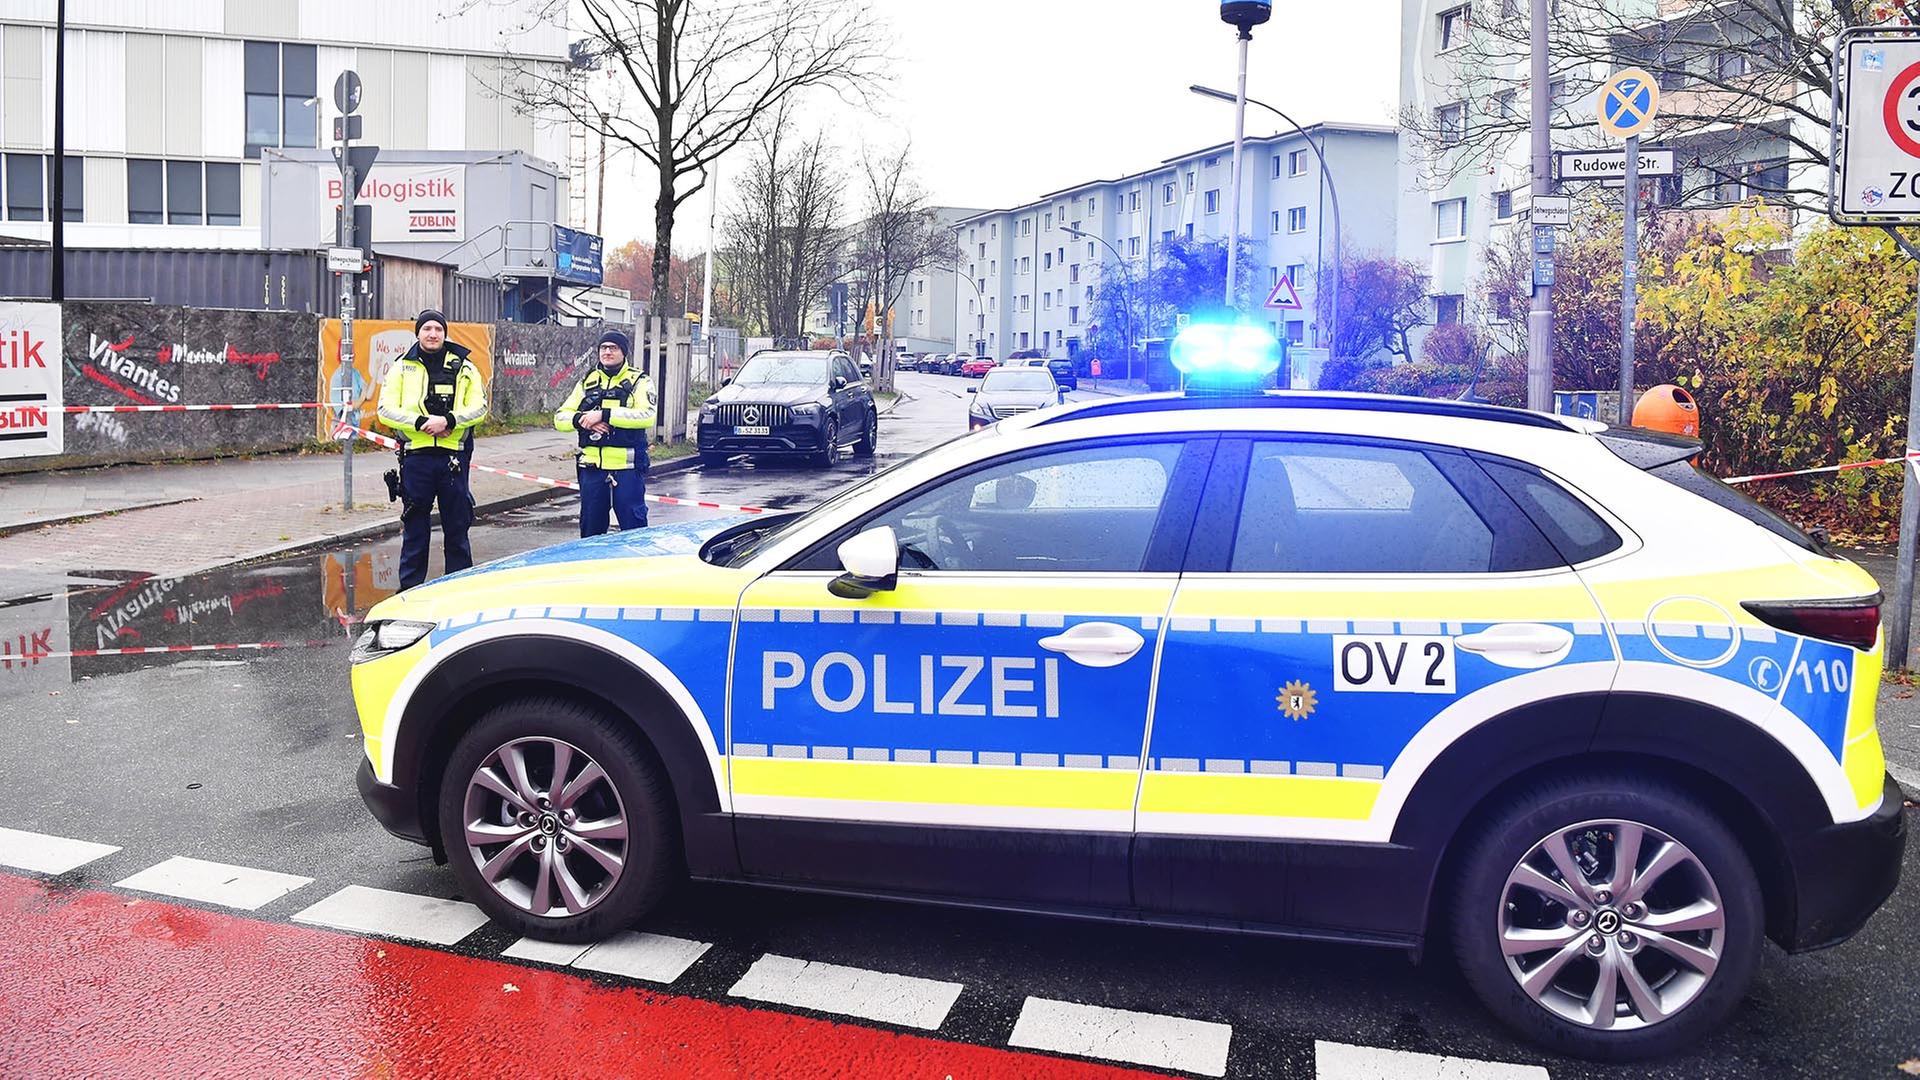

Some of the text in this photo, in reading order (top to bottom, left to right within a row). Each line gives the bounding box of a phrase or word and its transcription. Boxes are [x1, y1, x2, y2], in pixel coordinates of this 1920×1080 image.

[1573, 158, 1626, 172] Rudowe
[1638, 156, 1660, 170] Str.
[328, 178, 456, 203] Bulogistik
[410, 215, 456, 227] ZÜBLIN
[89, 333, 180, 403] Vivantes
[1341, 641, 1446, 686] OV 2
[1796, 659, 1848, 694] 110
[762, 651, 1060, 718] POLIZEI
